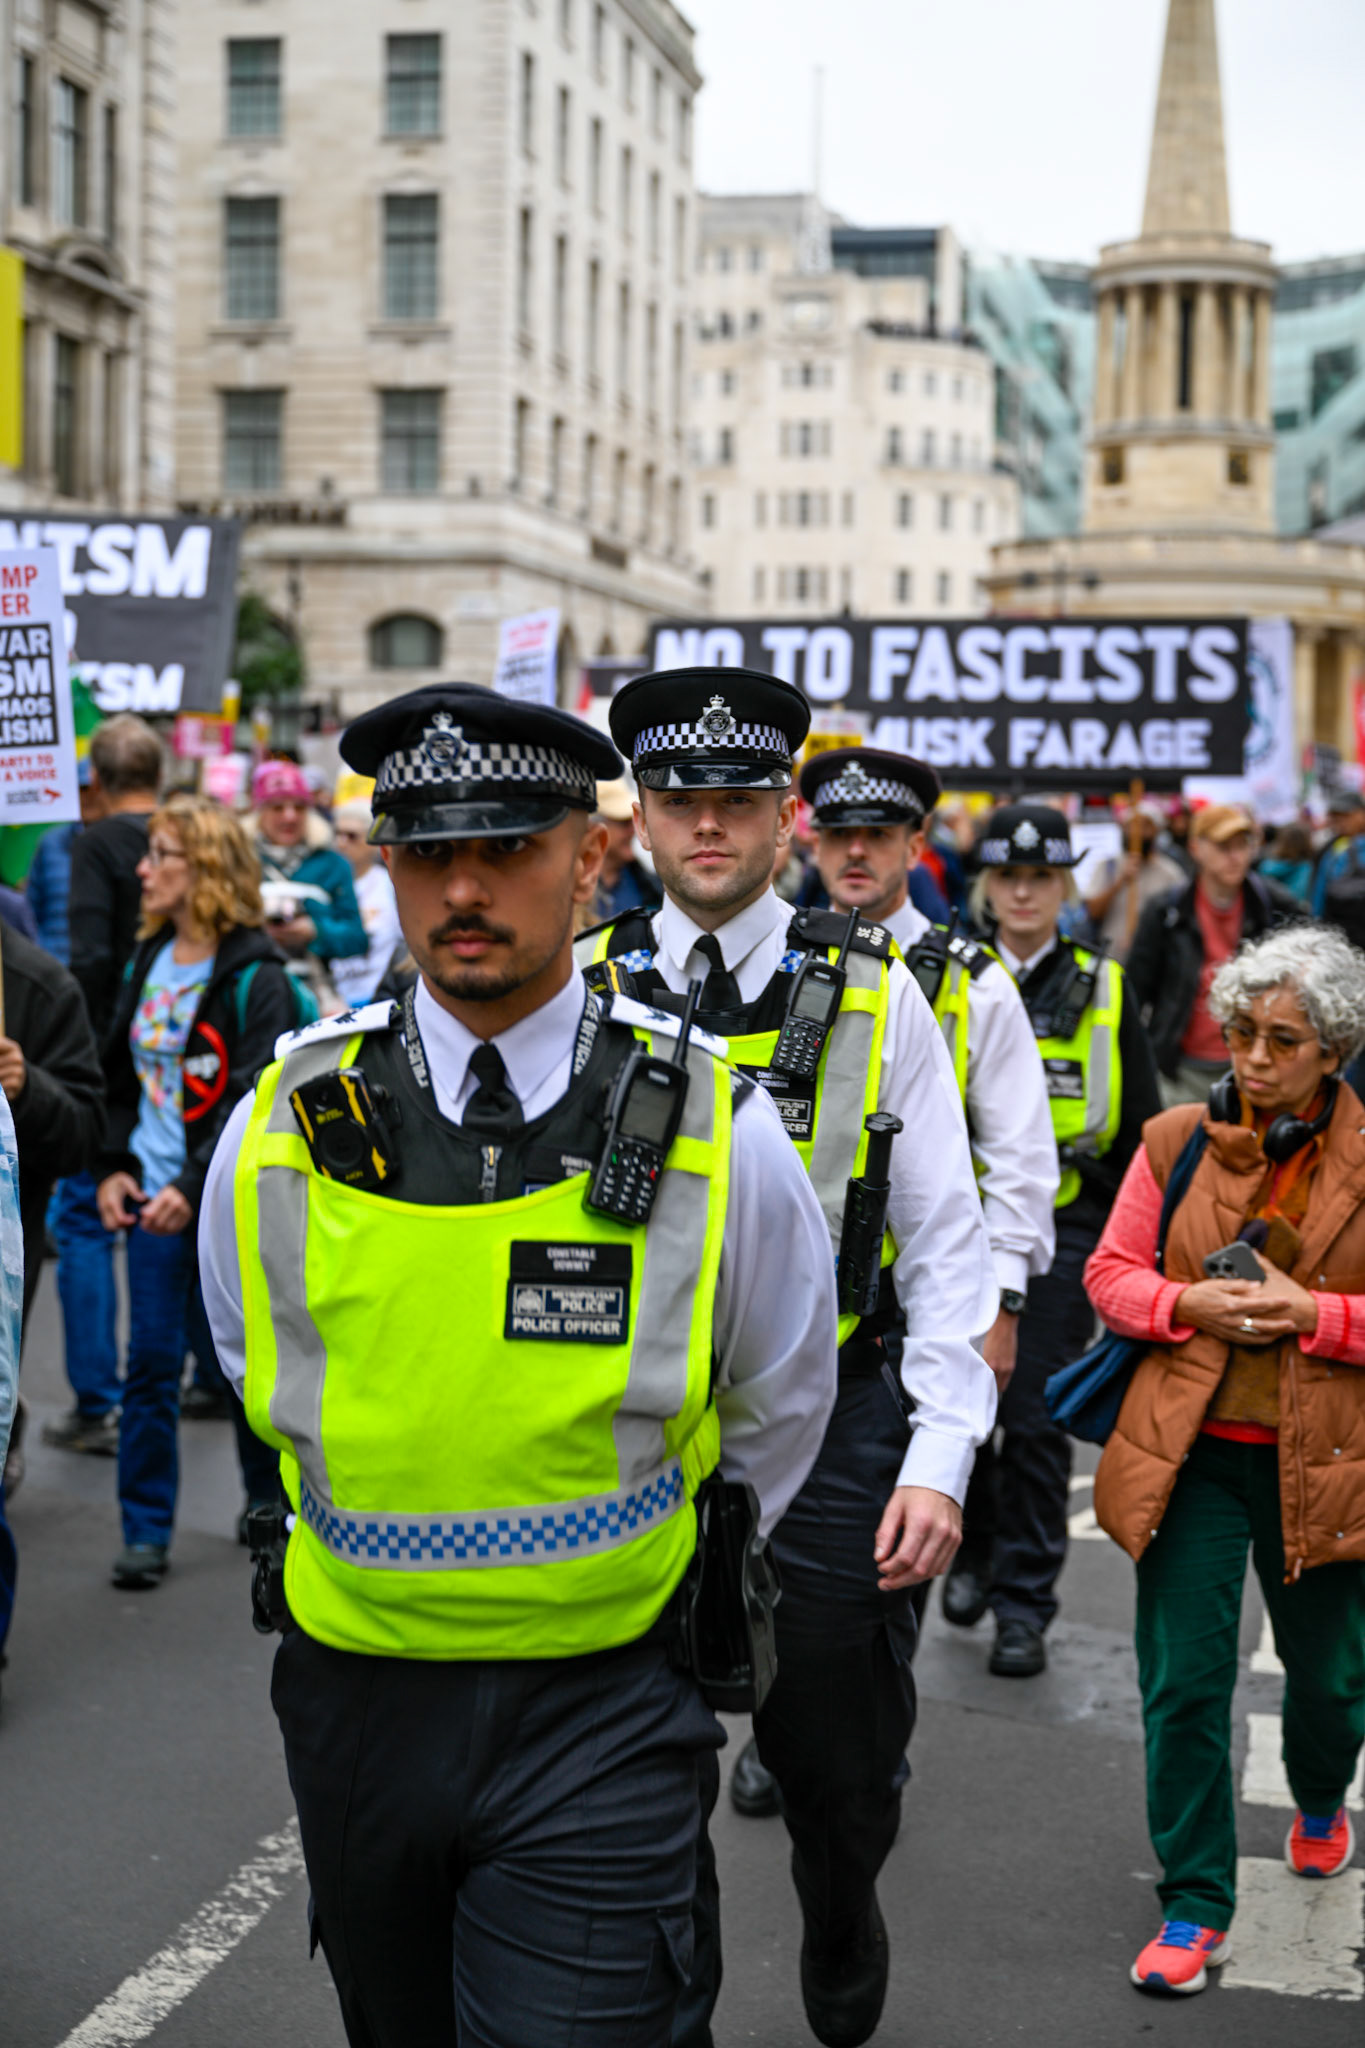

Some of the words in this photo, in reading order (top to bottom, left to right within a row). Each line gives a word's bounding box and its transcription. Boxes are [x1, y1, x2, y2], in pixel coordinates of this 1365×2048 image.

[761, 626, 854, 700] TO
[868, 625, 1240, 702] FASCISTS
[866, 717, 996, 769] MUSK
[1007, 718, 1212, 770] FARAGE
[573, 1019, 598, 1075] OFFICER
[546, 1247, 597, 1260] CONSTABLE
[552, 1290, 616, 1301] METROPOLITAN
[561, 1299, 606, 1314] POLICE
[513, 1317, 560, 1334] POLICE
[564, 1319, 621, 1336] OFFICER
